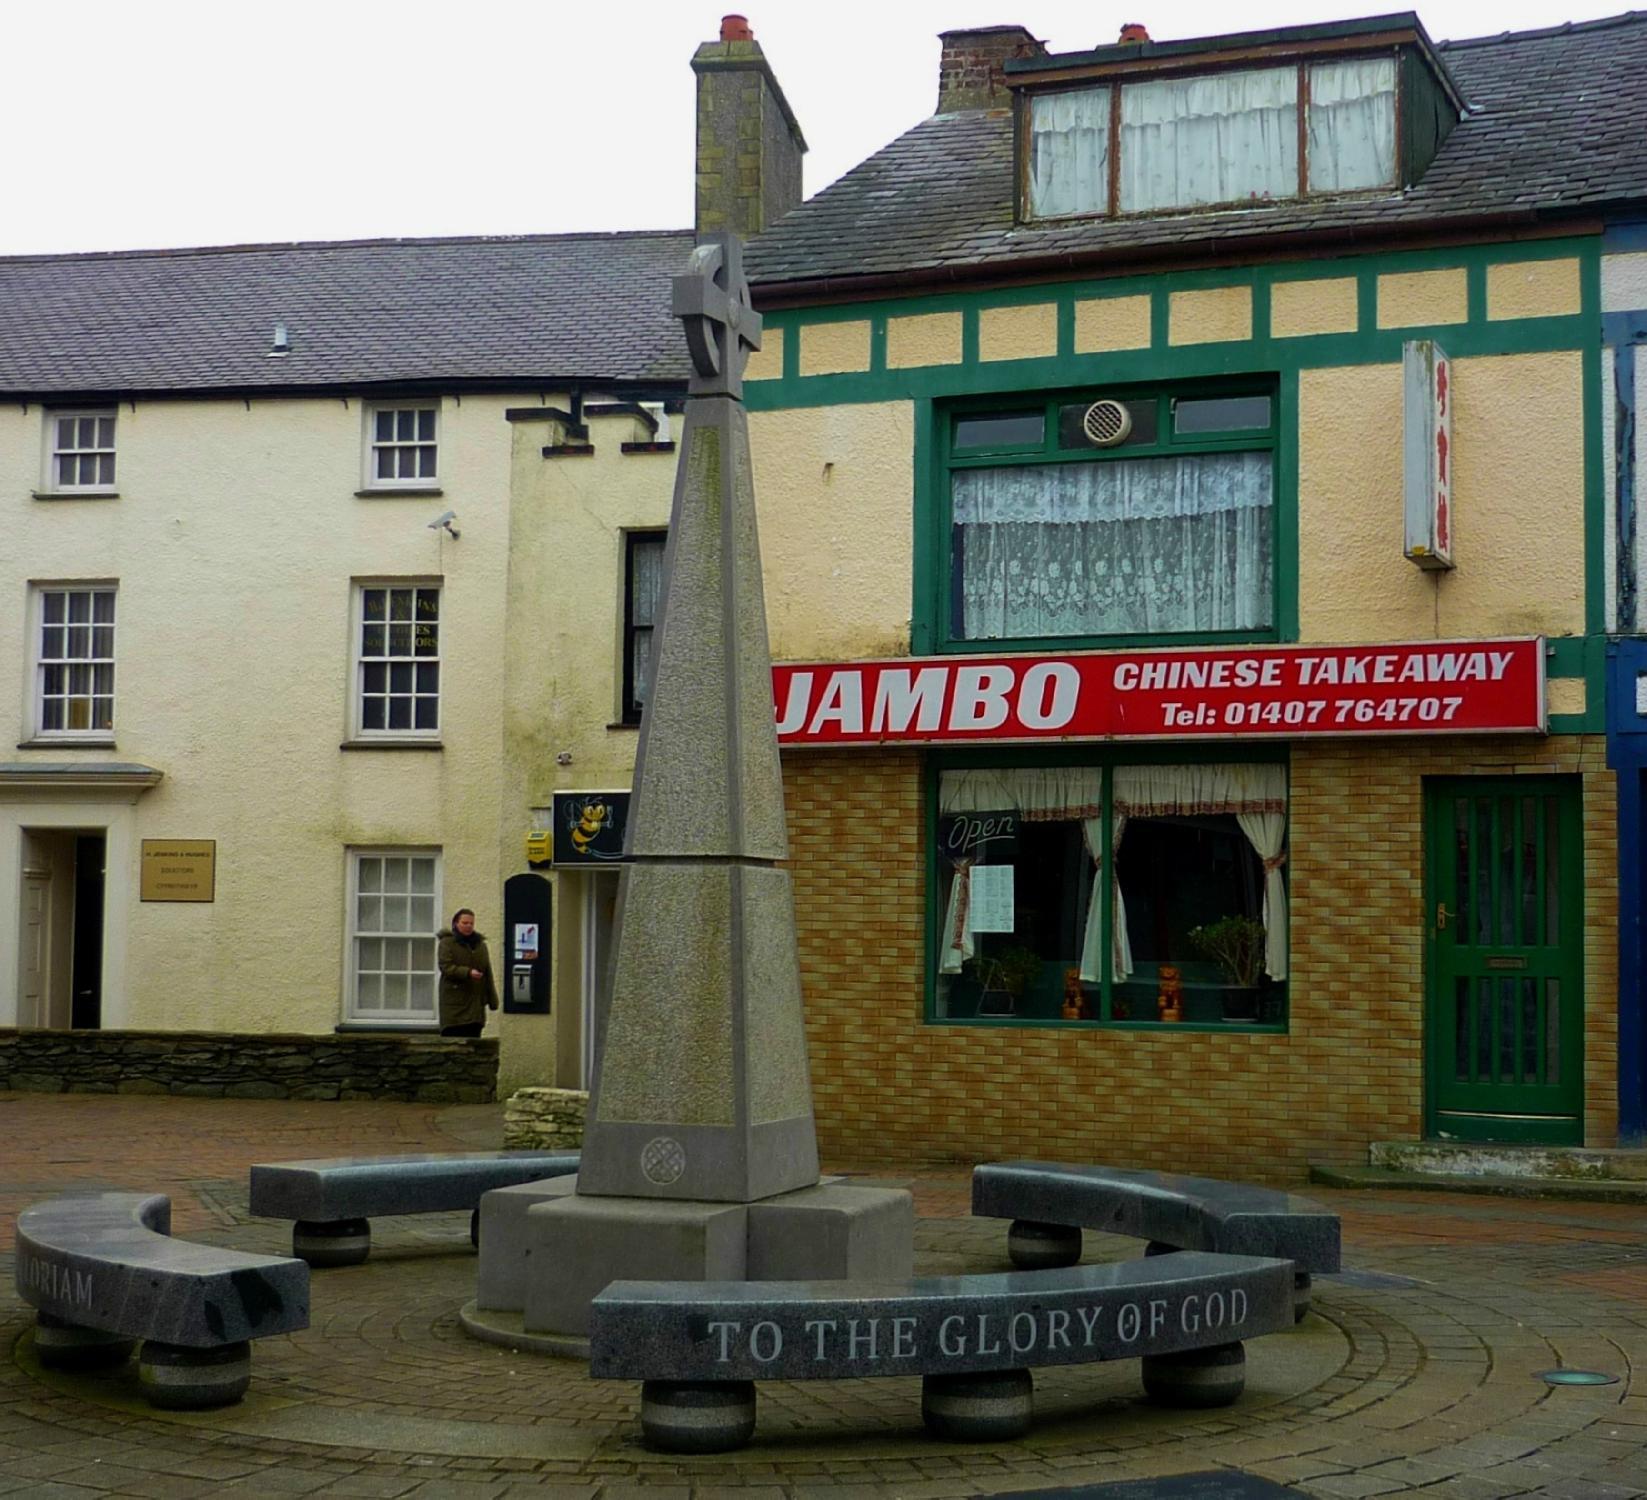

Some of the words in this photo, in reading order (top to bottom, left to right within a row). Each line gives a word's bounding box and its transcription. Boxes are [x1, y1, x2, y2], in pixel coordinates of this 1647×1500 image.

[774, 661, 1081, 736] JAMBO
[1112, 657, 1284, 692] CHINESE
[1294, 650, 1514, 686] TAKEAWAY
[1162, 702, 1216, 727] Tel:
[1224, 699, 1322, 725] 01407
[1333, 696, 1464, 722] 764707
[948, 815, 1014, 853] Open
[706, 1320, 784, 1362] TO
[805, 1316, 919, 1361] THE
[938, 1305, 1102, 1356] GLORY
[1116, 1298, 1168, 1343] OF
[1179, 1287, 1248, 1335] GOD
